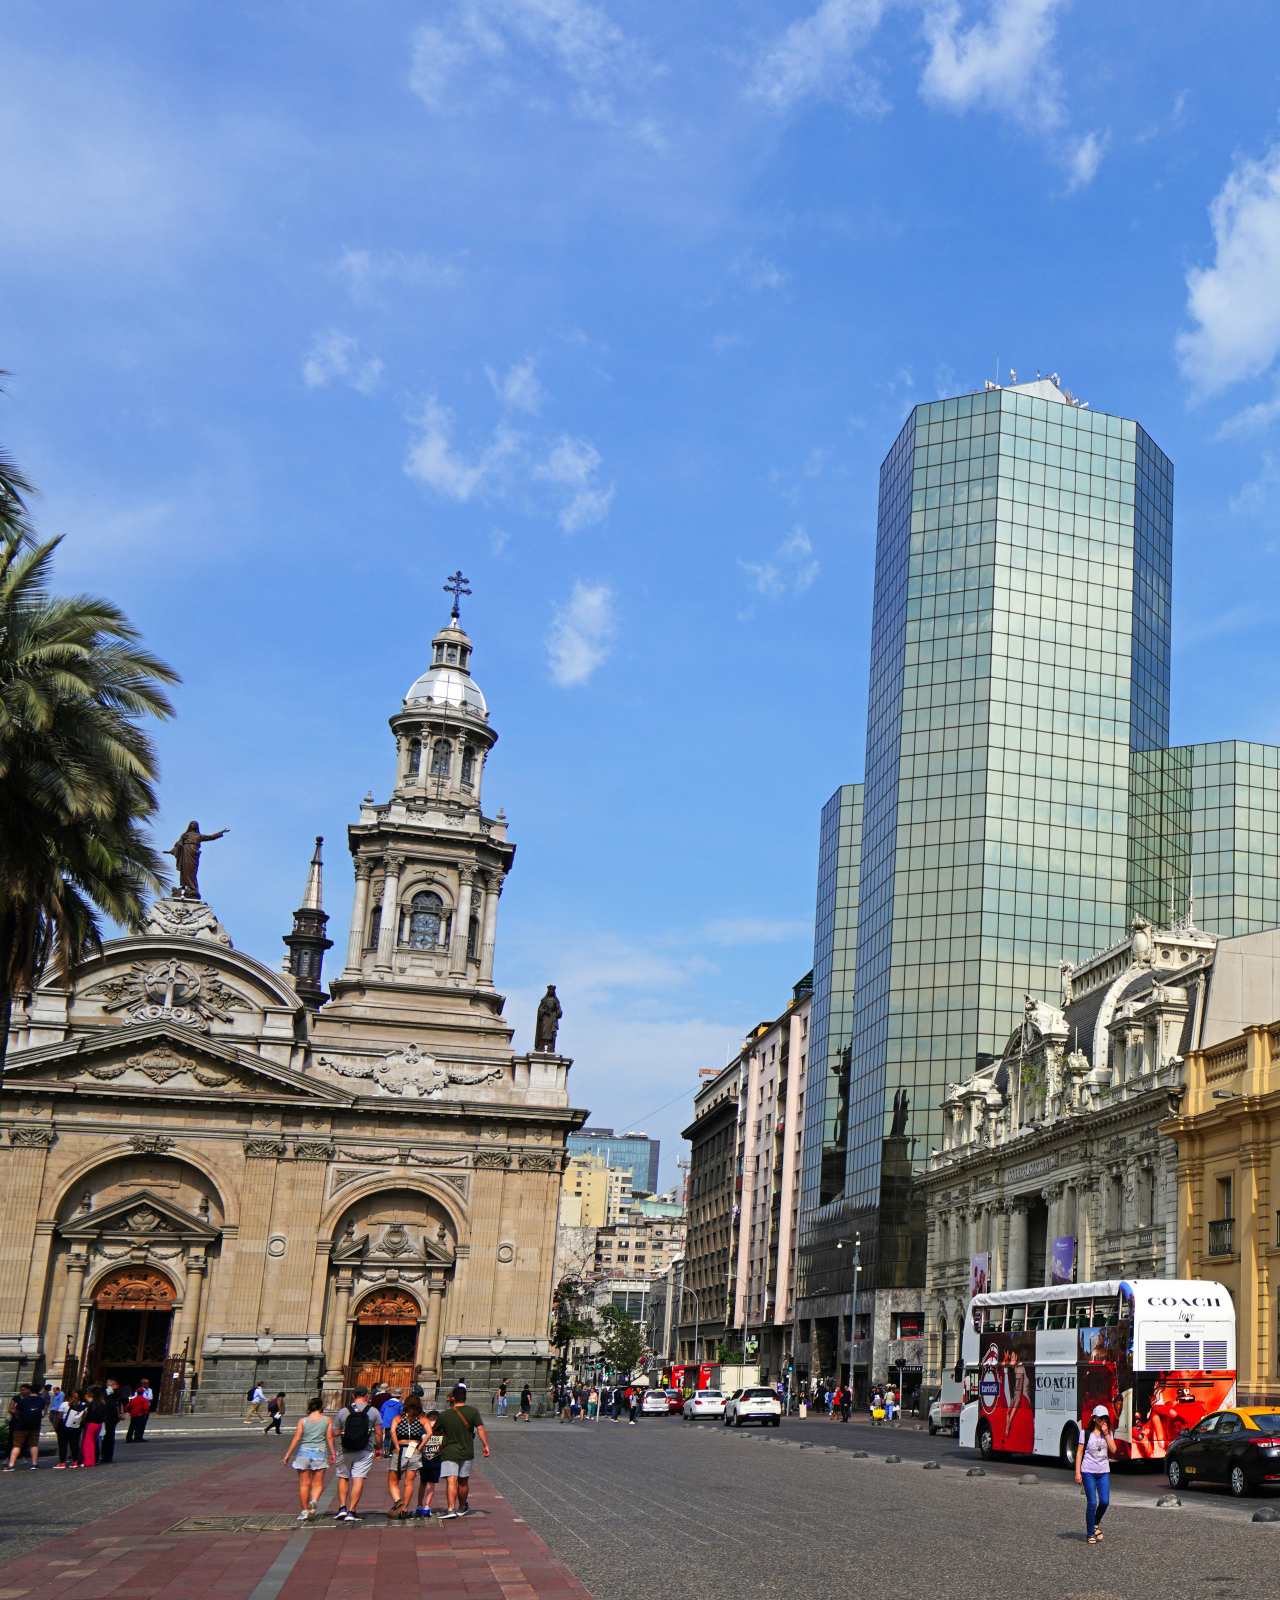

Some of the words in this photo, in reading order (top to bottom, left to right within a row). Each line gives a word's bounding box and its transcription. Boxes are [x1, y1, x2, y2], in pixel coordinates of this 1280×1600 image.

[1147, 1297, 1220, 1307] COACH
[1178, 1310, 1194, 1320] love
[1036, 1376, 1075, 1389] COACH
[982, 1384, 998, 1393] turistik
[1051, 1394, 1060, 1406] love
